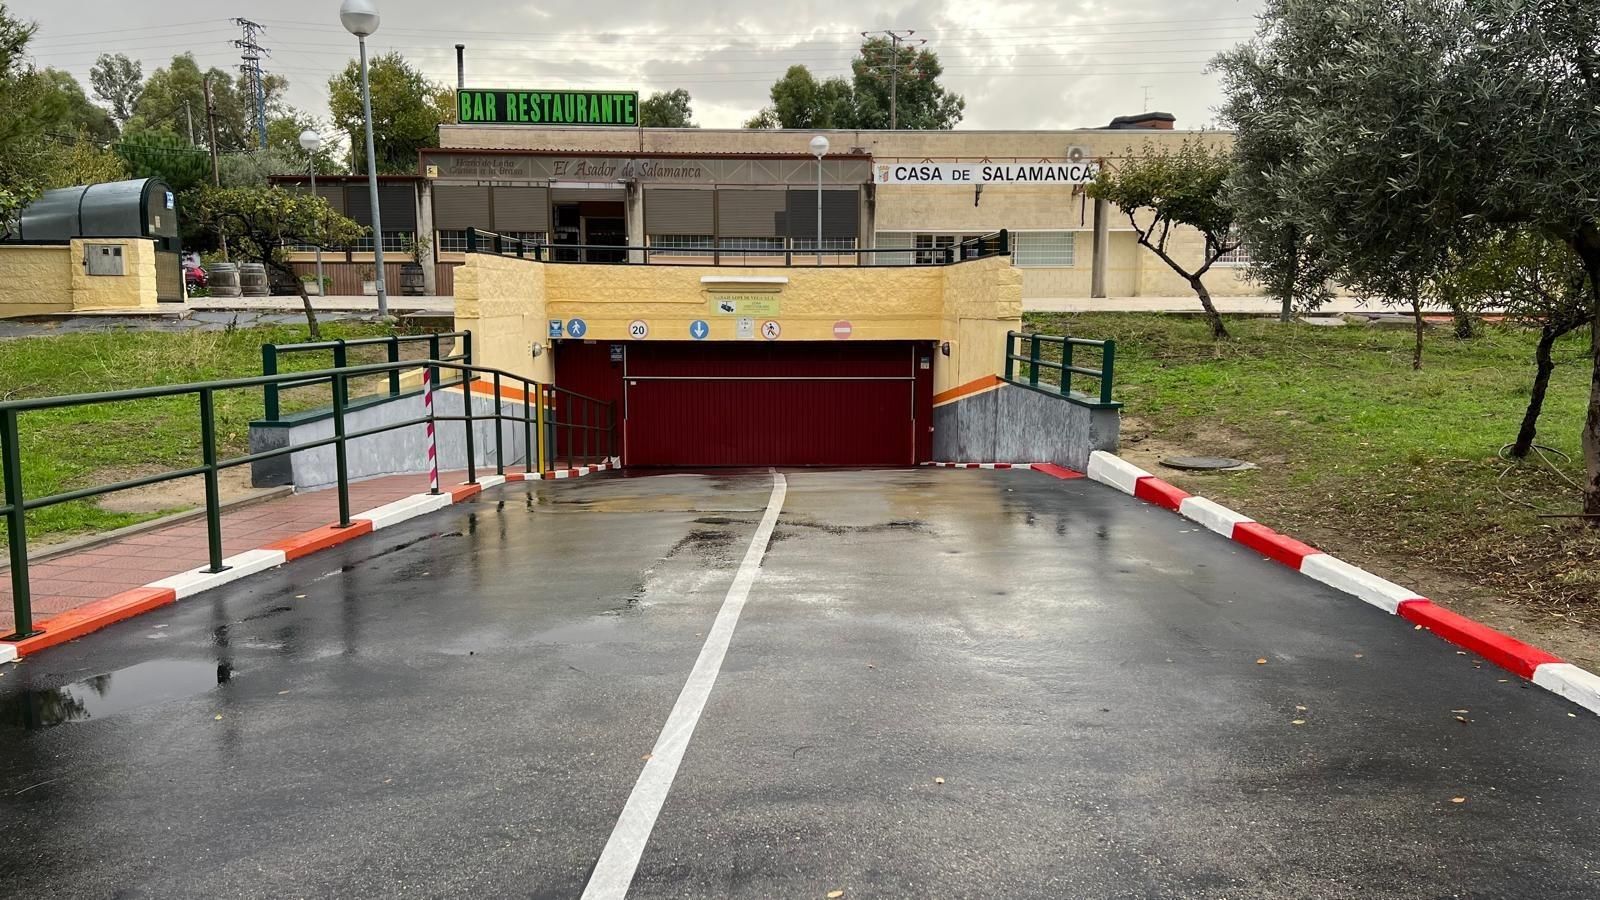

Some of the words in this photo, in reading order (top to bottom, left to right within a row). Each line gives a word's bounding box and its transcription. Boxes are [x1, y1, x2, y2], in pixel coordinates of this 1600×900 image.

[461, 93, 496, 121] BAR
[507, 93, 634, 123] RESTAURANTE
[553, 160, 569, 176] El
[574, 160, 616, 177] Asador
[622, 161, 634, 177] de
[638, 162, 701, 177] Salamanca
[895, 166, 943, 181] CASA
[952, 169, 971, 181] DE
[982, 166, 1093, 181] SALAMANCA
[632, 325, 645, 335] 20
